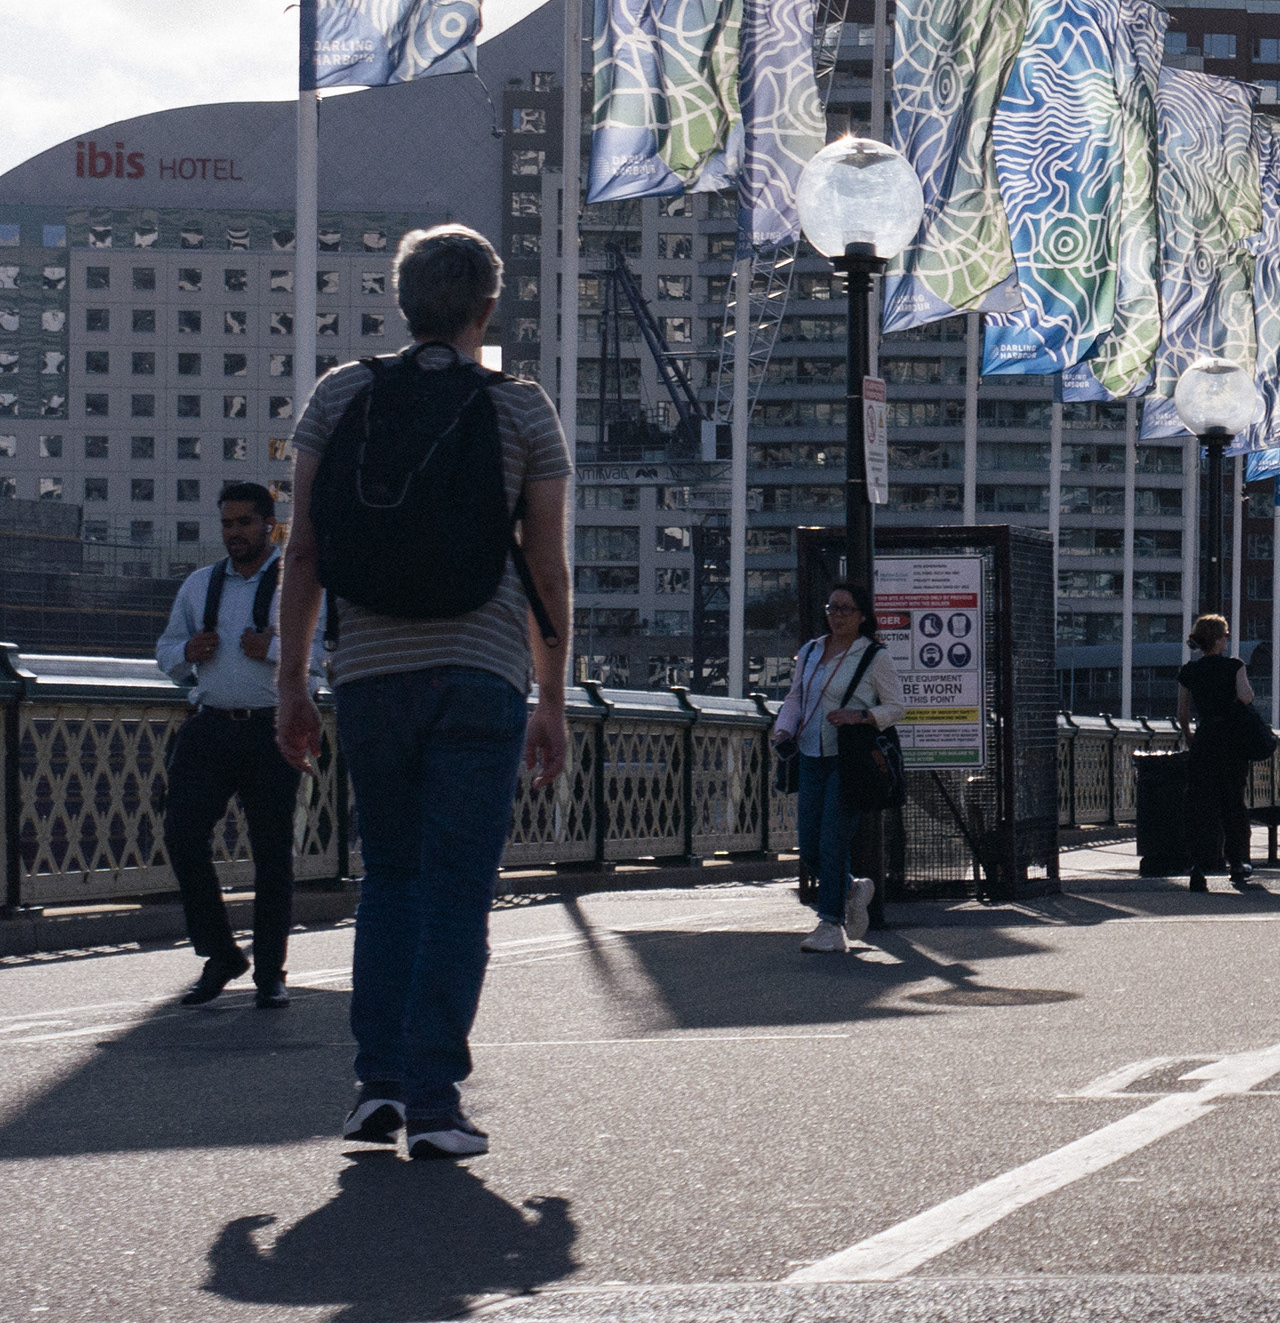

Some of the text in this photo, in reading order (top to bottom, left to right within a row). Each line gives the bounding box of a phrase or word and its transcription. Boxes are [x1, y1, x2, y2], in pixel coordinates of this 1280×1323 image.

[76, 141, 243, 181] ibis HOTEL
[1000, 344, 1037, 352] DARLING
[877, 616, 901, 624] GER
[903, 683, 962, 694] BE WORN
